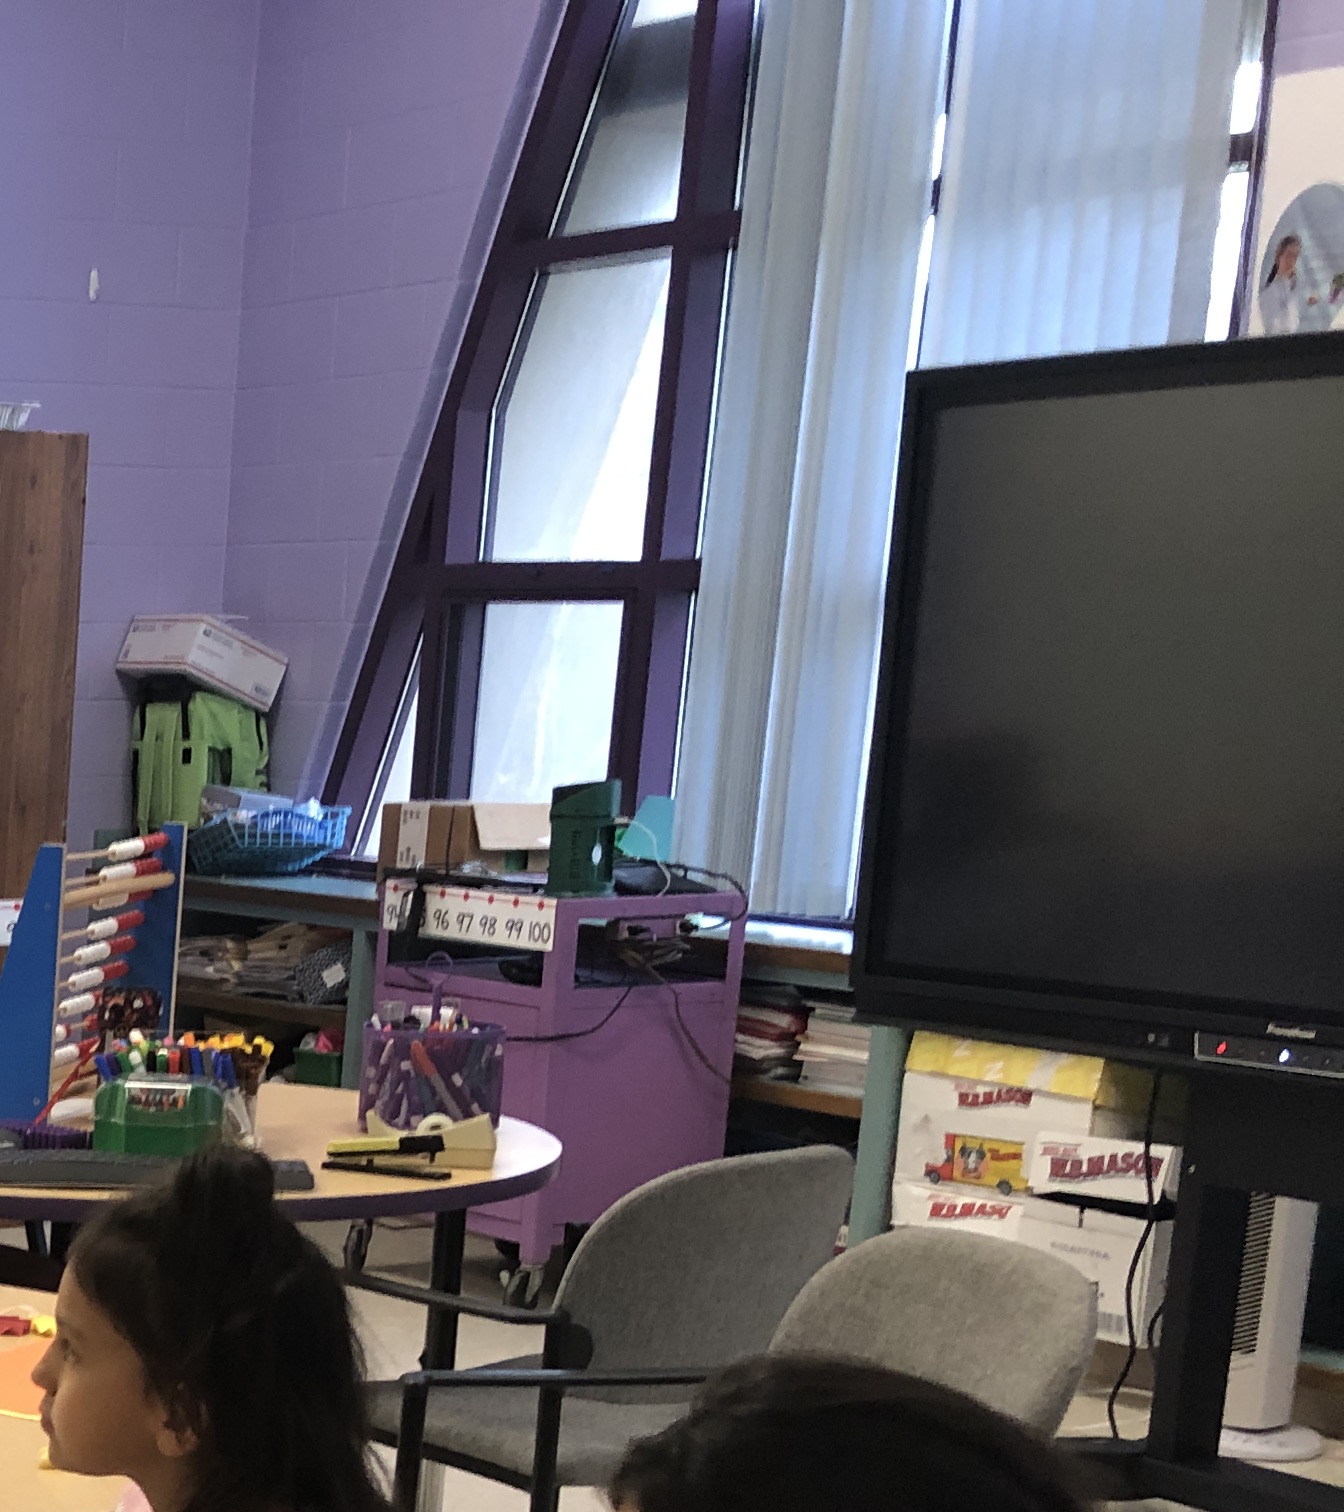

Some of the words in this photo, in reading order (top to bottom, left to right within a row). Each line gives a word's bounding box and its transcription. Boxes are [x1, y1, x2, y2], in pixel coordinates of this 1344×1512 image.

[433, 908, 450, 931] 96
[456, 911, 475, 934] 97
[479, 915, 498, 937] 98
[505, 918, 524, 941] 99
[528, 920, 551, 945] 100
